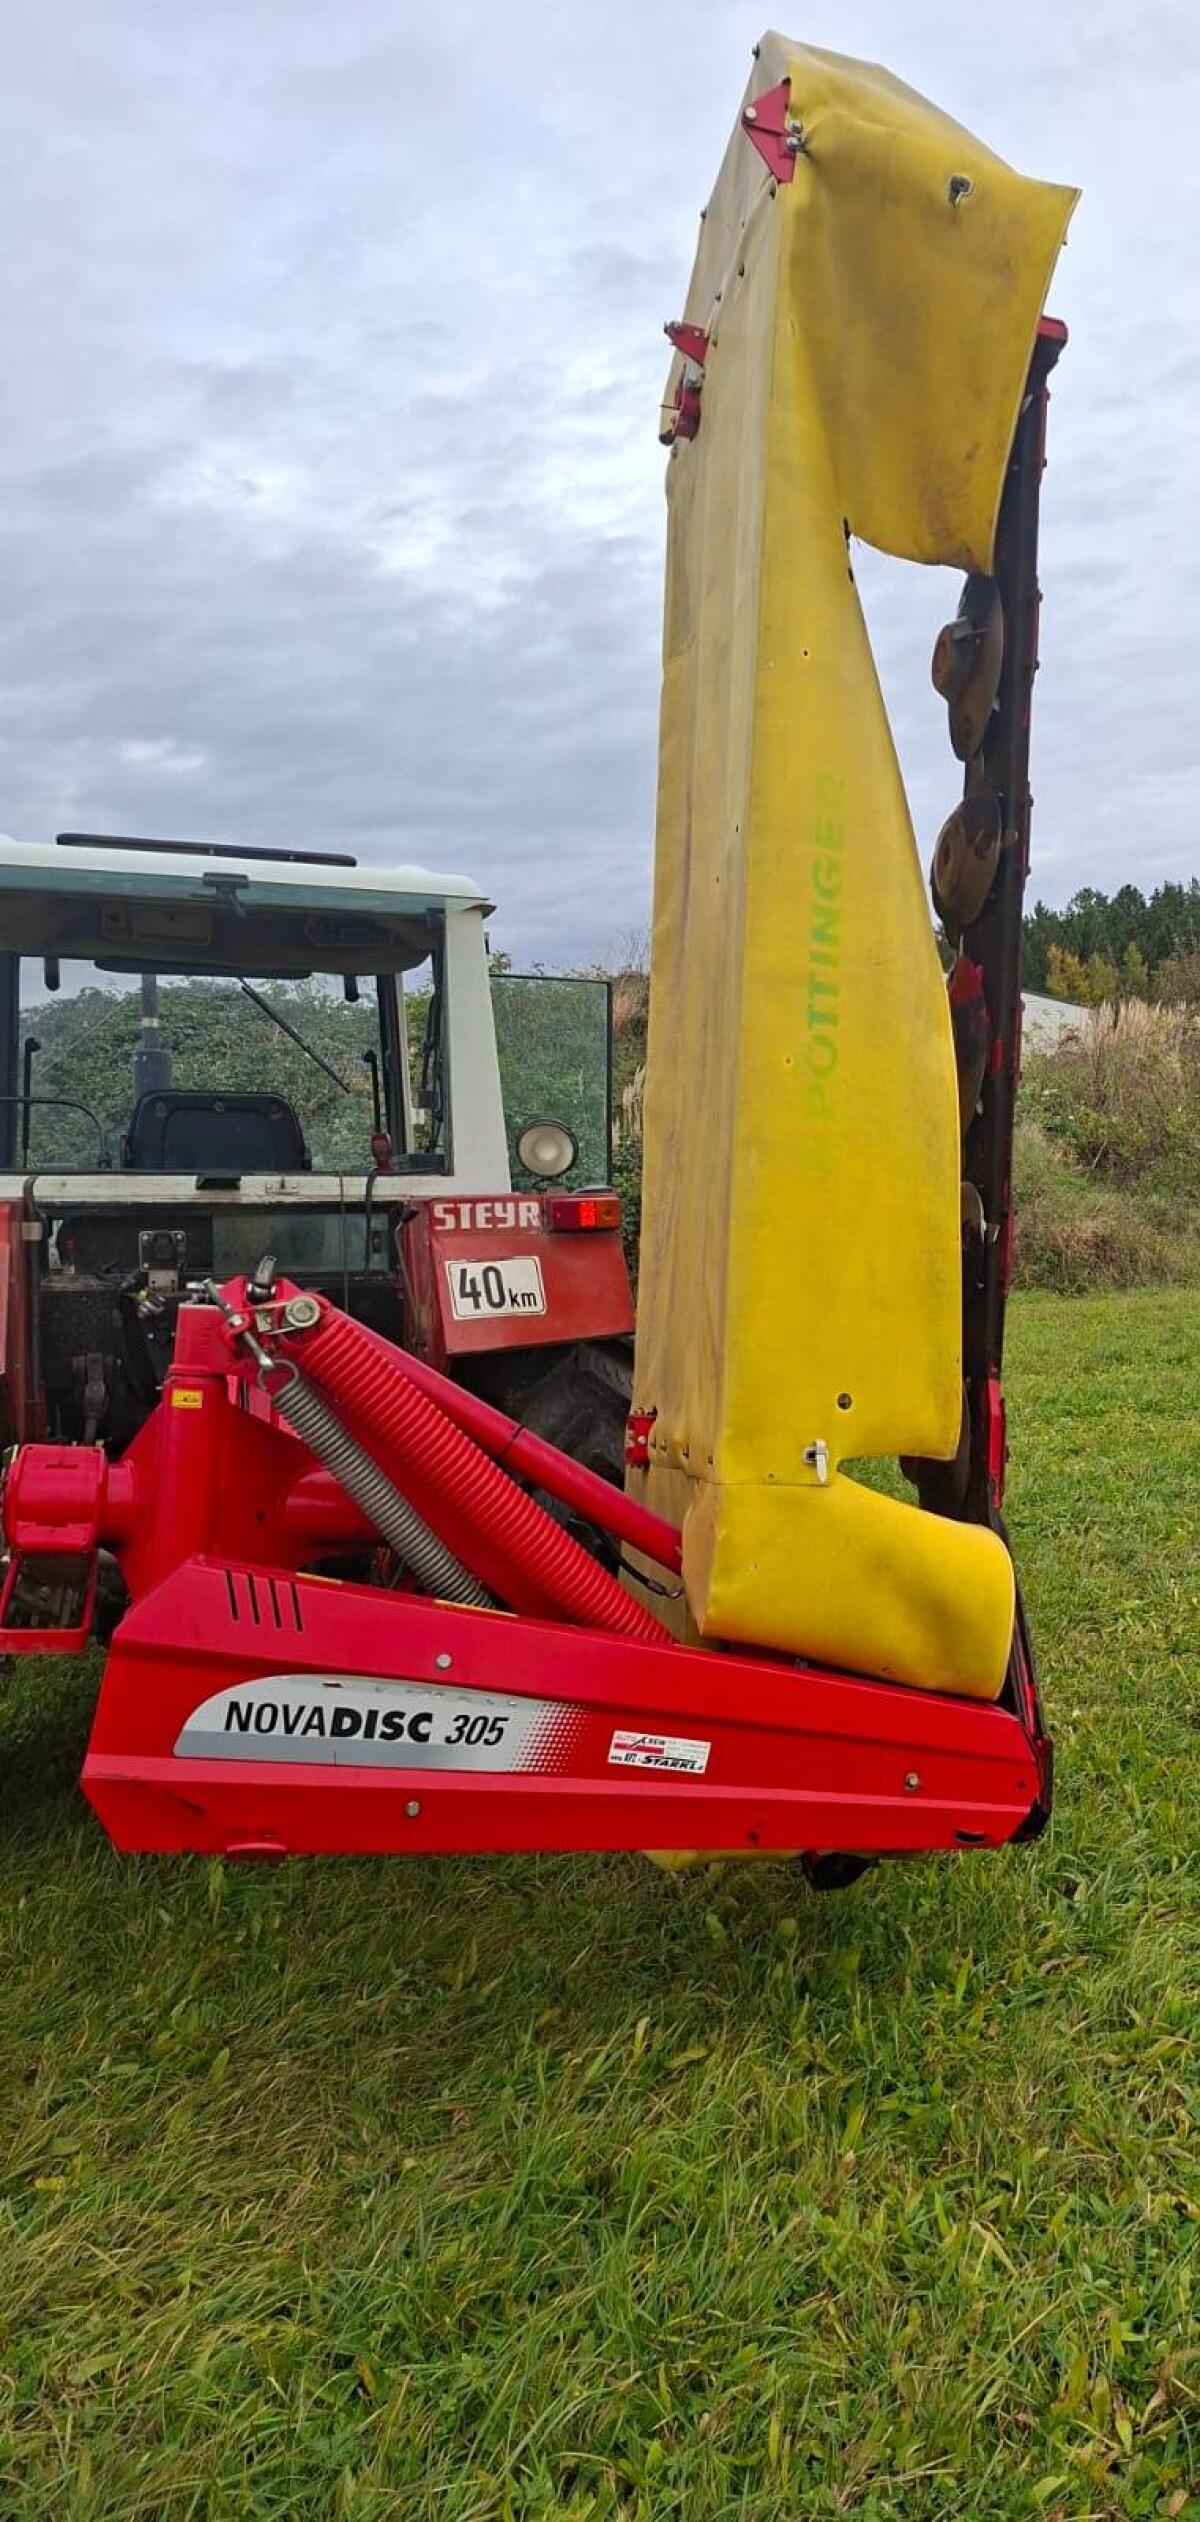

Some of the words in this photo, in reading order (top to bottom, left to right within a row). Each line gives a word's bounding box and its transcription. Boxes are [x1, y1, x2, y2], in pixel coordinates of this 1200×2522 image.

[433, 1200, 541, 1231] STEYR
[224, 1700, 433, 1743] NOVADISC
[444, 1713, 509, 1746] 305
